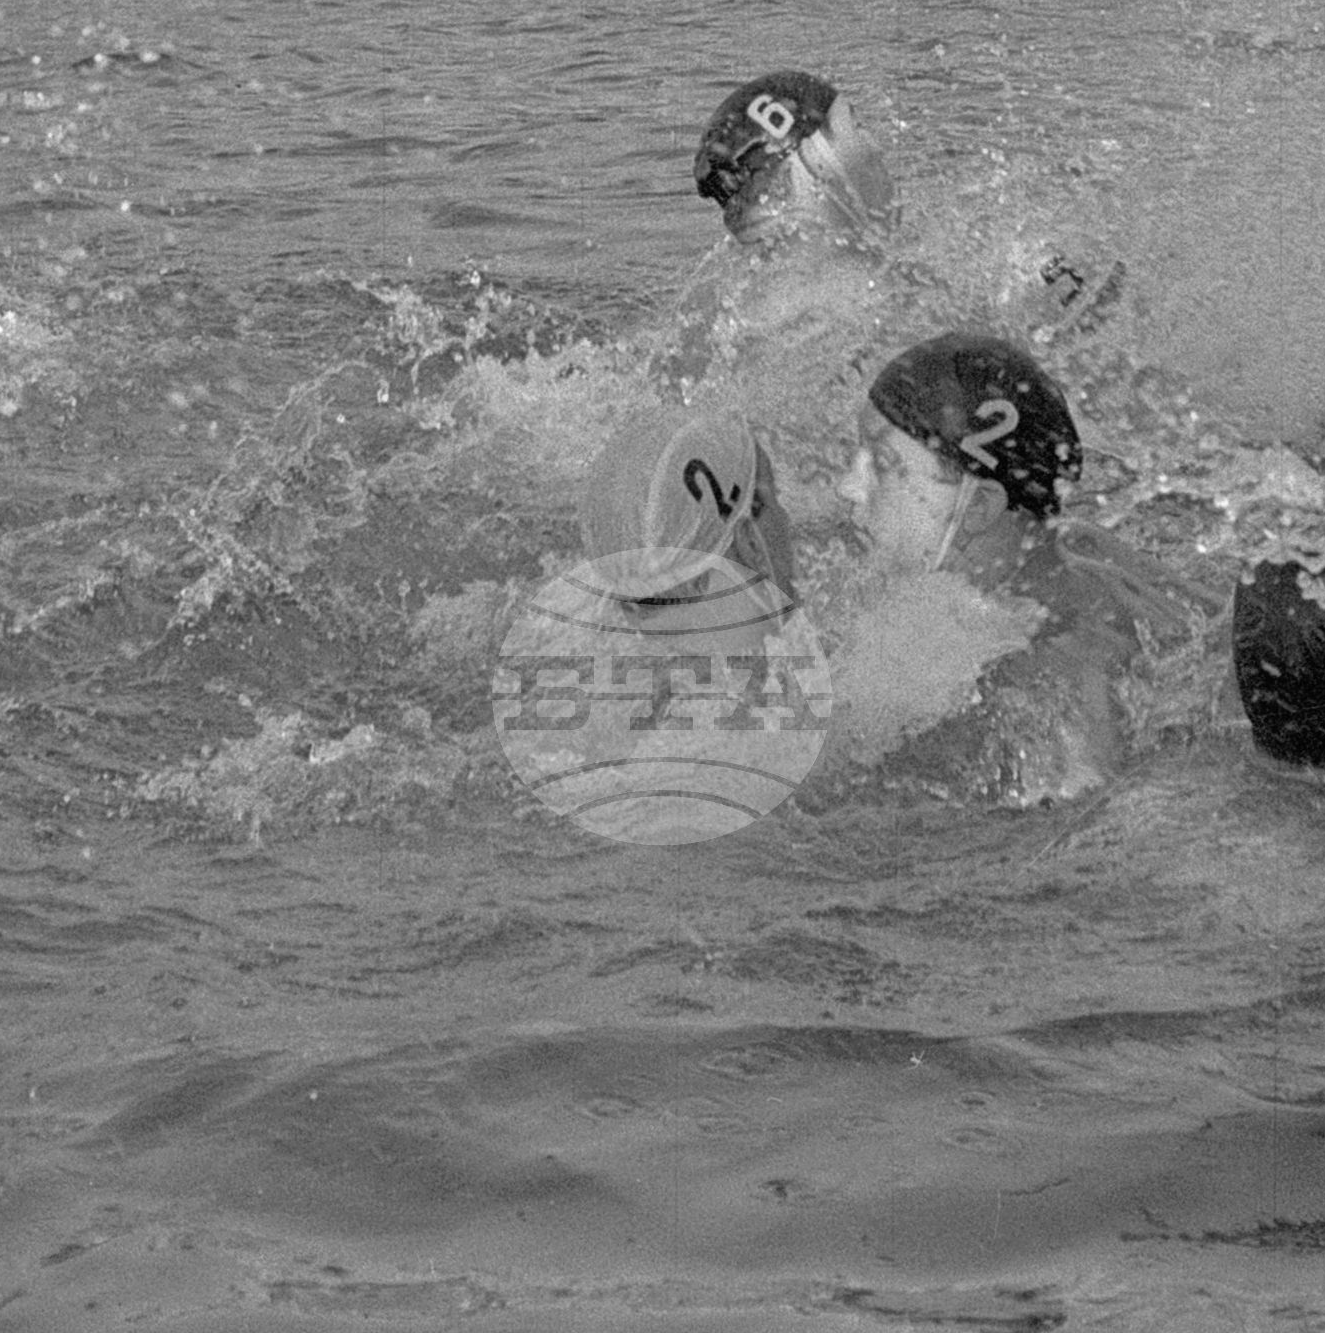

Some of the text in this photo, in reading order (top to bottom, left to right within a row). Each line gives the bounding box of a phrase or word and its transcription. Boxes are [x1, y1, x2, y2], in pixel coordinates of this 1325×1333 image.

[746, 94, 795, 140] 6
[960, 398, 1020, 470] 2
[683, 458, 742, 518] 2
